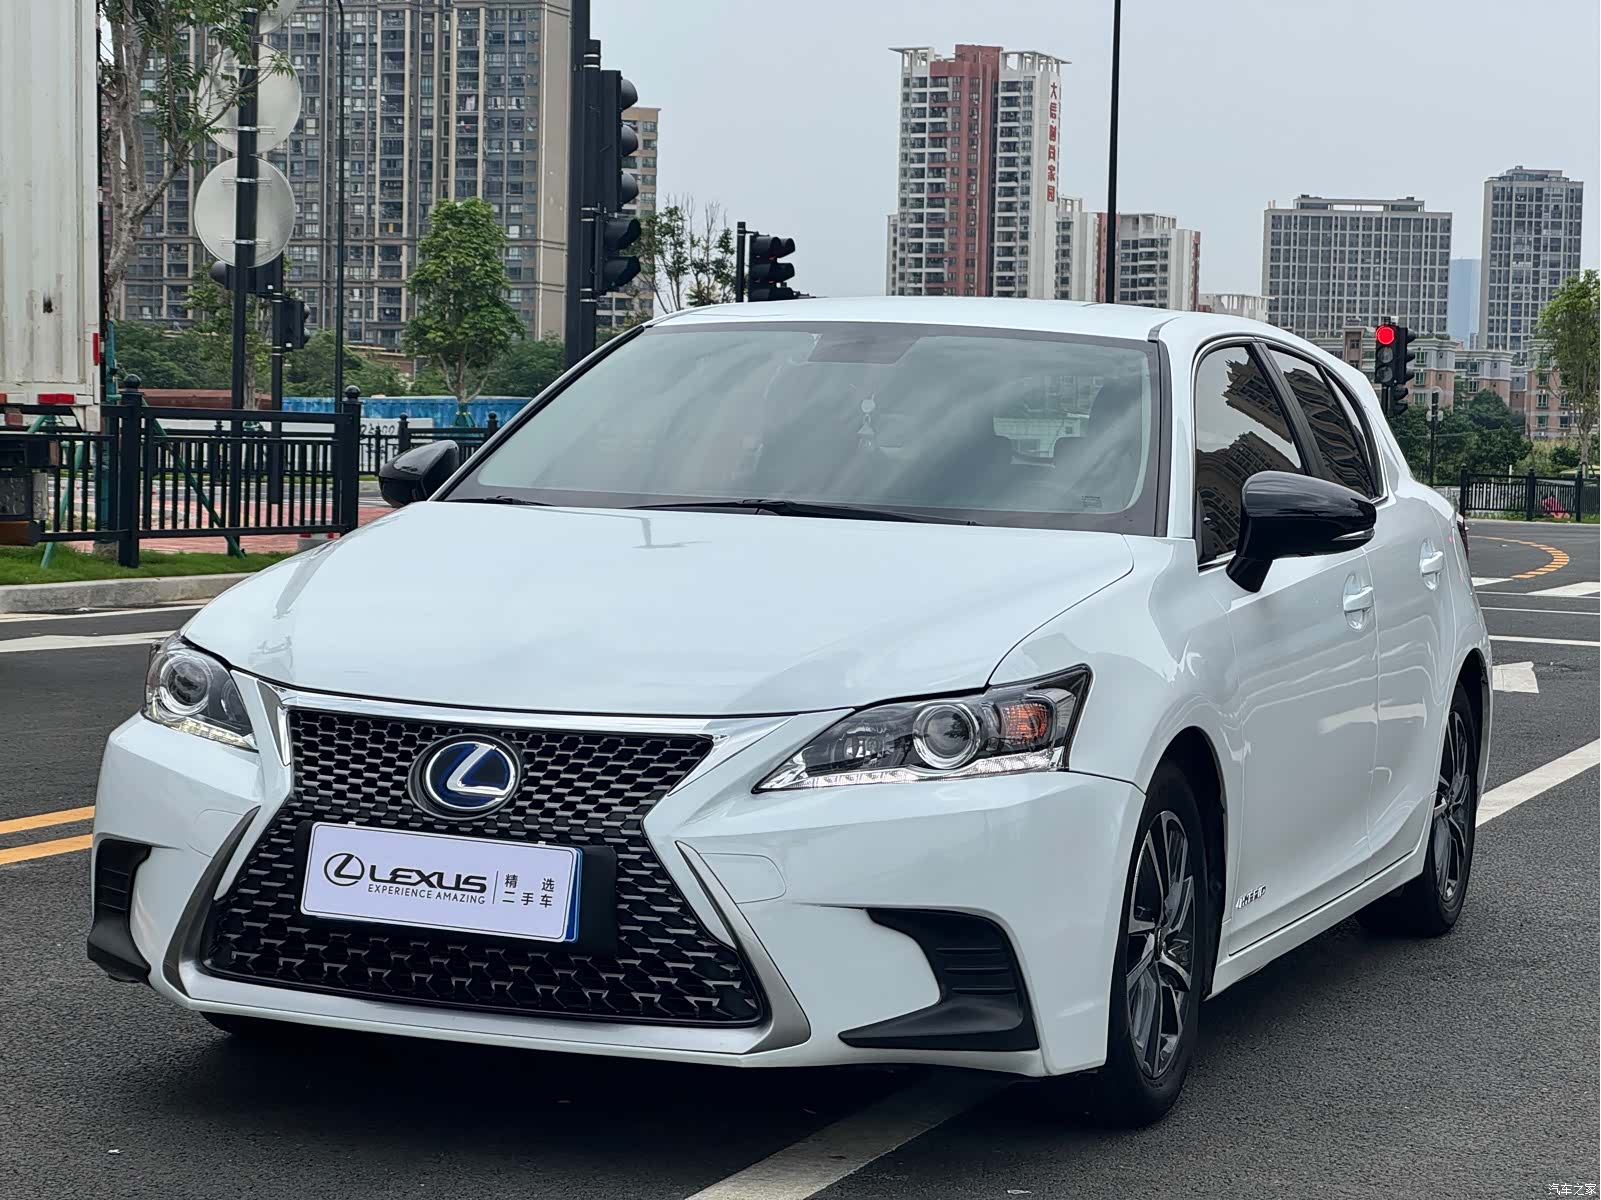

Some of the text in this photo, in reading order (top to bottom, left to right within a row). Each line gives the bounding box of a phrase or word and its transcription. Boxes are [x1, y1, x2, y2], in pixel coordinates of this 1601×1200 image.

[369, 864, 487, 894] LEXUS
[505, 874, 556, 893] 精选
[368, 884, 486, 904] EXPERIENCE AMAZING
[502, 891, 554, 908] 二手车
